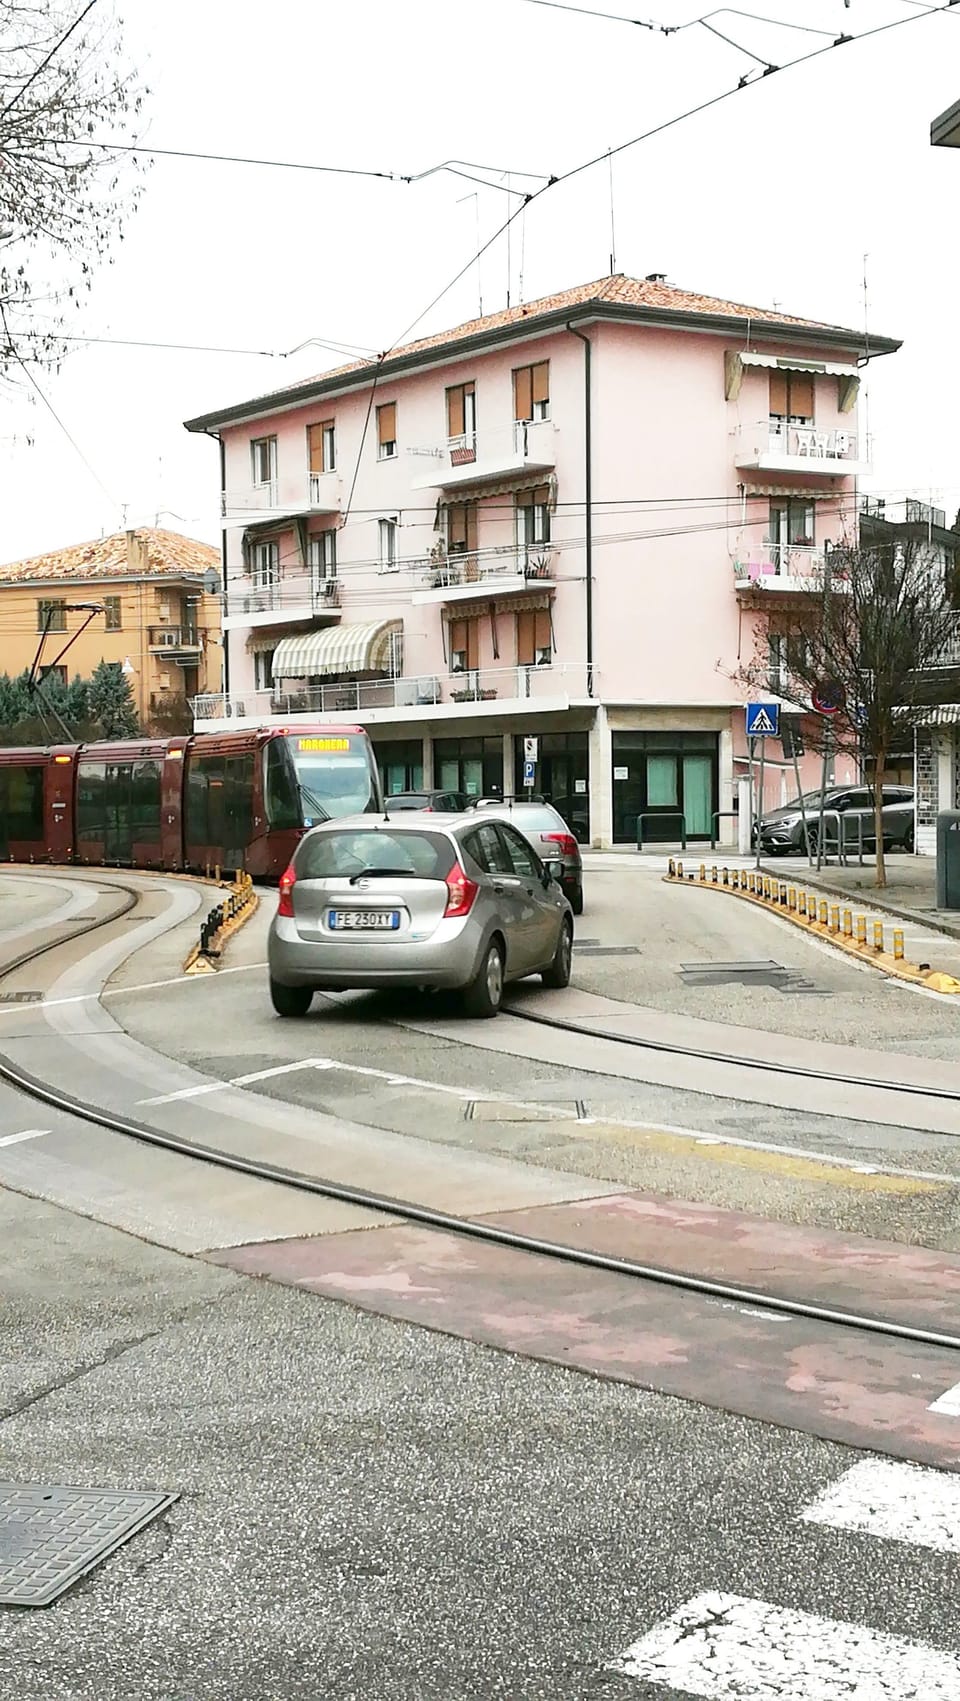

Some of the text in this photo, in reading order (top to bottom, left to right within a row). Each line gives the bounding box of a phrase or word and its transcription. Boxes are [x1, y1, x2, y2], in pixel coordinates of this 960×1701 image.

[299, 739, 350, 750] MARGHERA
[526, 763, 533, 777] P
[337, 913, 351, 925] FE
